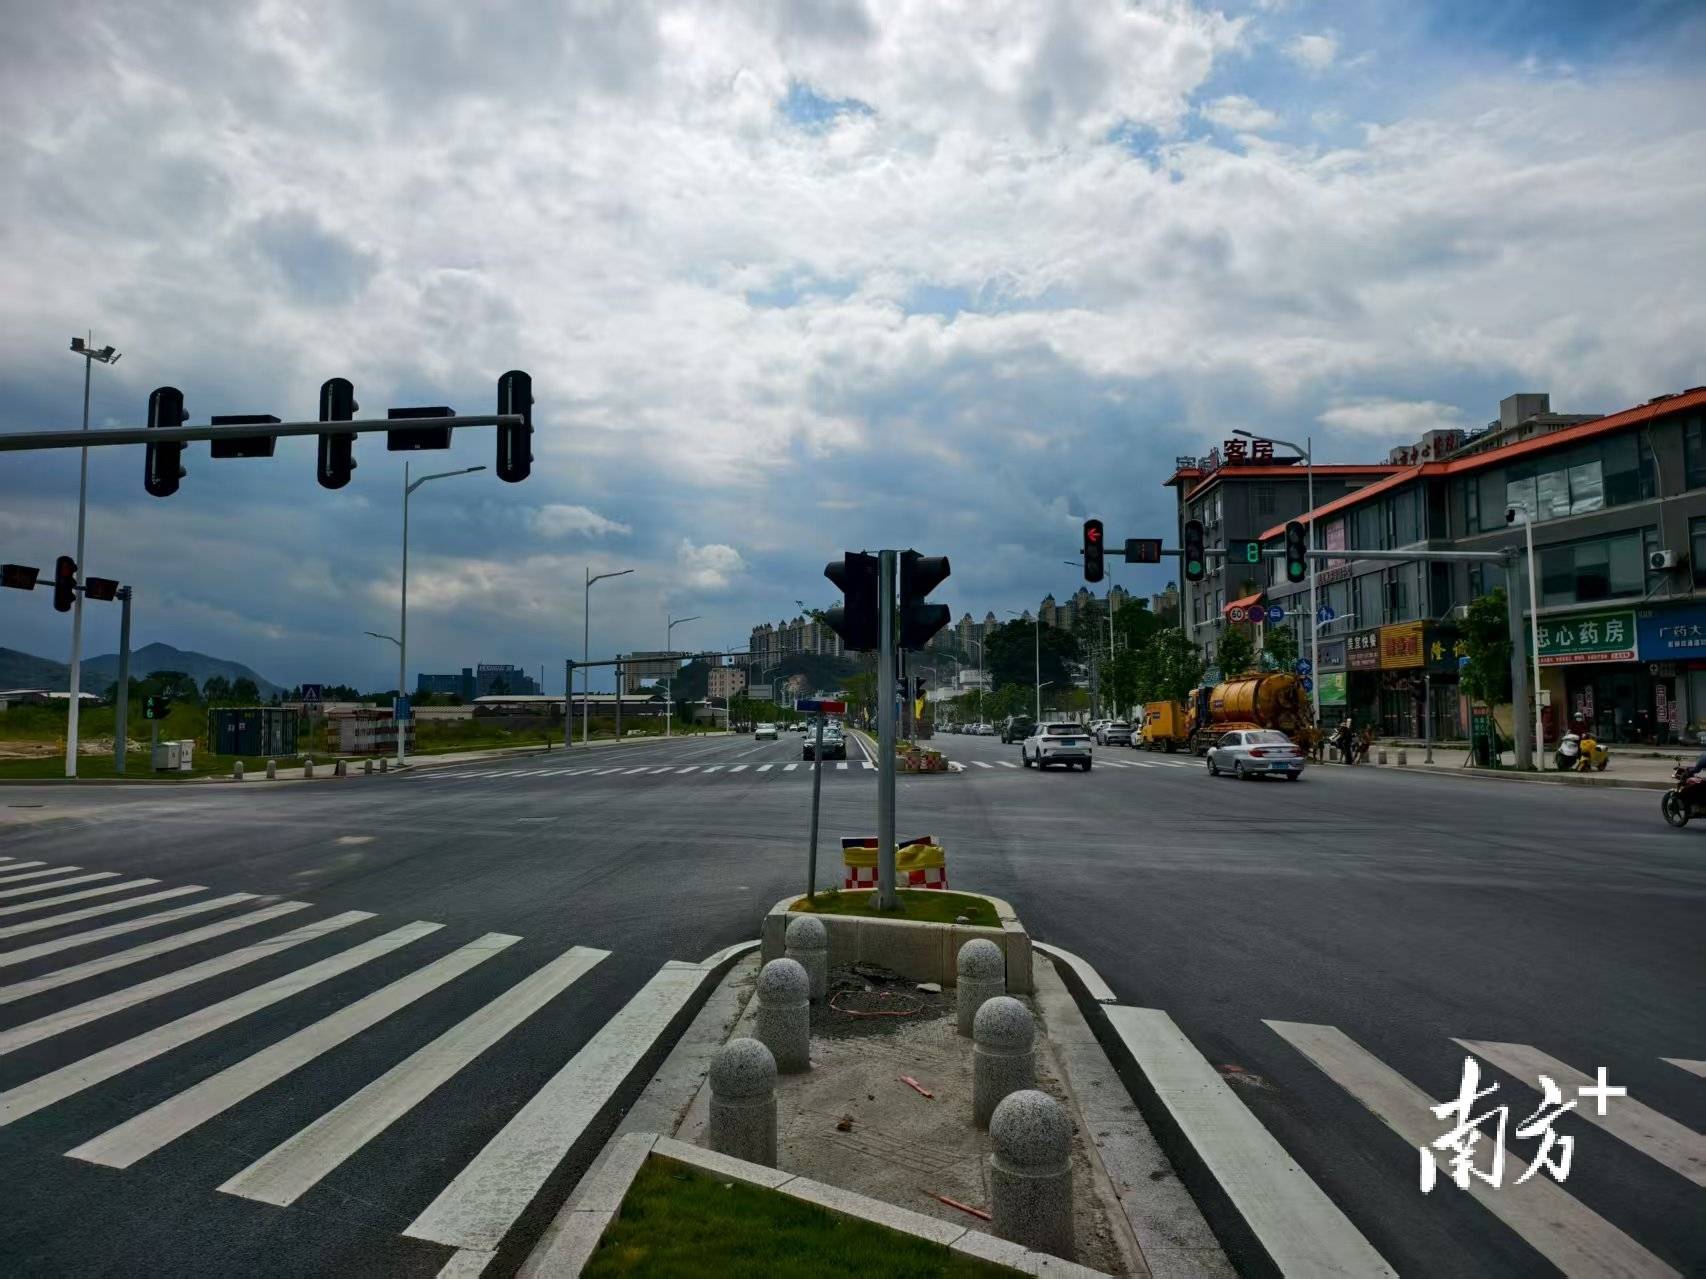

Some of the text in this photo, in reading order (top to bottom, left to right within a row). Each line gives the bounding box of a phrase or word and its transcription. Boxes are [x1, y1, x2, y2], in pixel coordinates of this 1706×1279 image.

[1224, 439, 1273, 465] 客房
[1246, 542, 1259, 562] 8
[1536, 618, 1625, 649] 忠心药房
